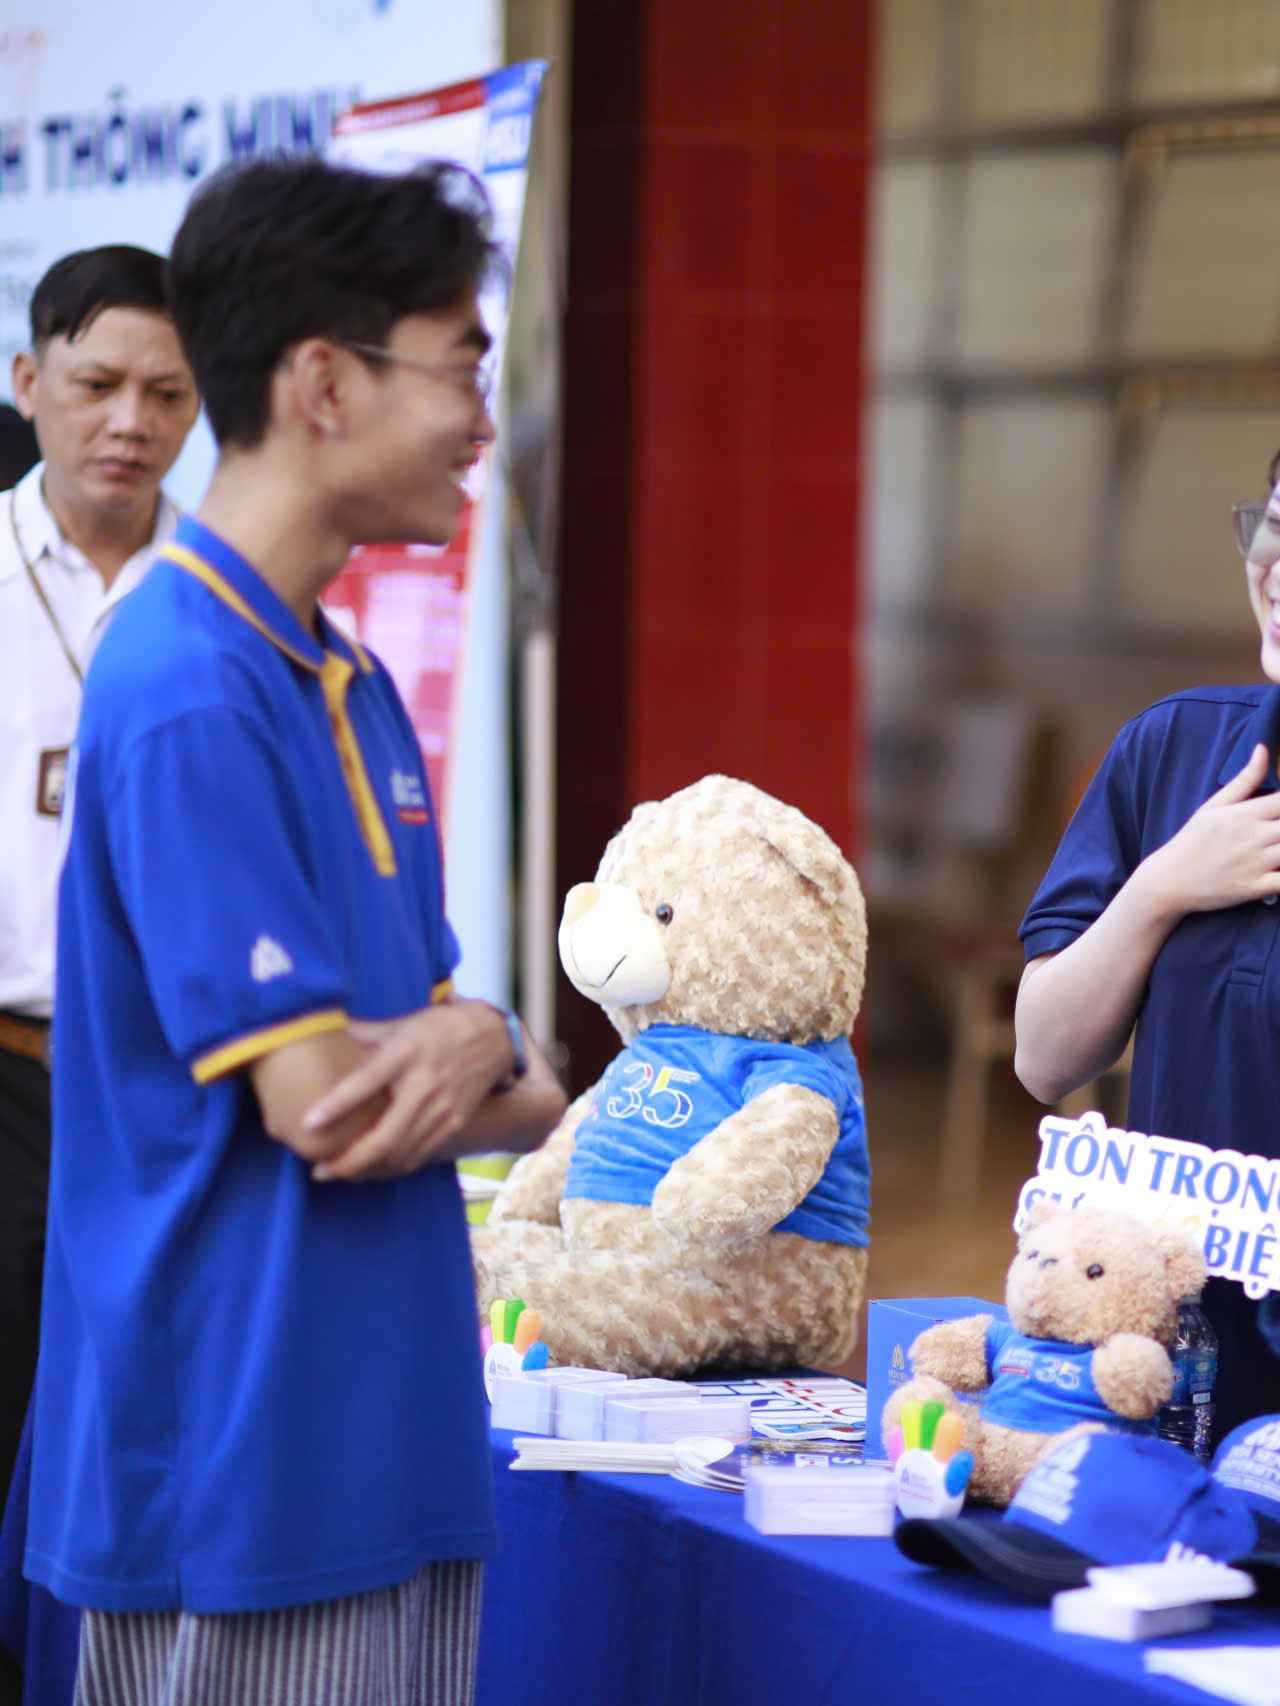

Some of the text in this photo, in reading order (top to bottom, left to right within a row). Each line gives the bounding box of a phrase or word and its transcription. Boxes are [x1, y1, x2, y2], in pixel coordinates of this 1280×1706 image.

[44, 85, 207, 192] THÔNG
[607, 1062, 699, 1129] 35
[1044, 1123, 1135, 1185] TÔN
[1035, 1356, 1083, 1390] 35
